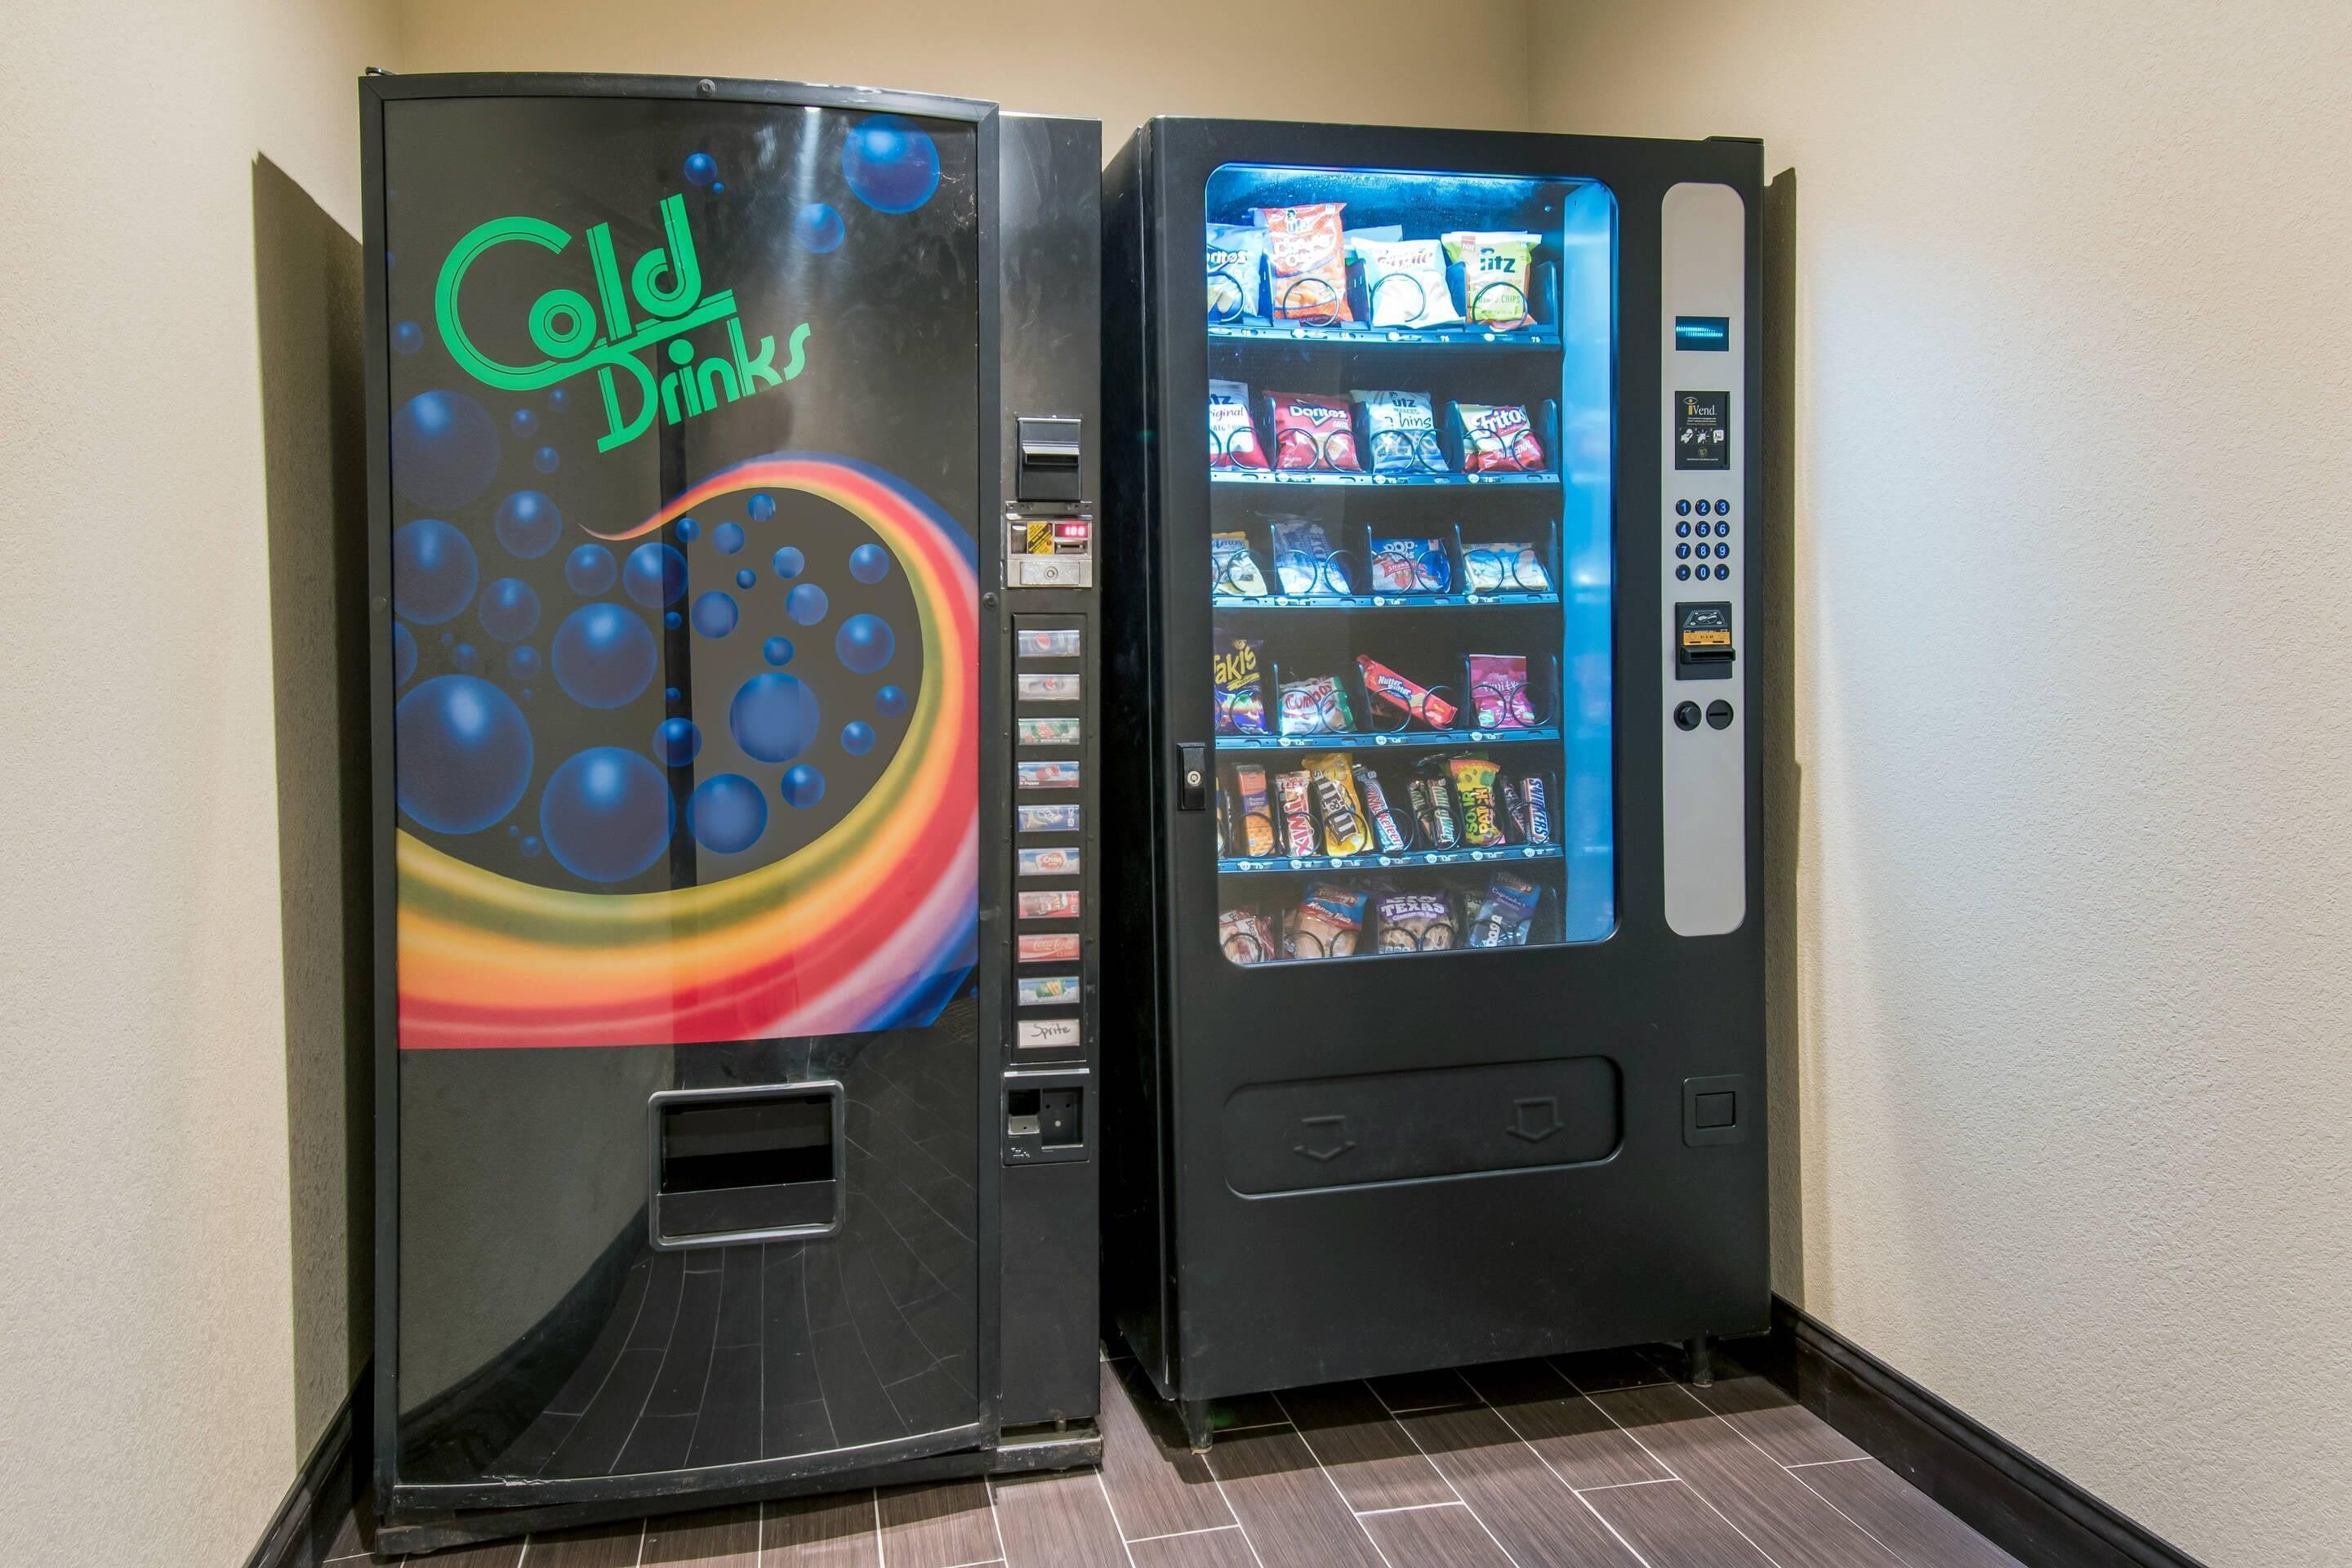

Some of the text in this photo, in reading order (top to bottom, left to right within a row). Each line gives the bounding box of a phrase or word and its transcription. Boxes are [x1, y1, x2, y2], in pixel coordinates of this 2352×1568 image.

[434, 193, 737, 392] Cold
[596, 317, 811, 453] Drinks
[1210, 407, 1244, 421] iginal
[1290, 405, 1348, 419] Doritos
[1471, 408, 1526, 437] Fritos
[1682, 502, 1726, 513] 1 2 3
[1681, 523, 1726, 534] 4 5 6
[1681, 546, 1726, 556] 7 8 9
[1700, 568, 1706, 577] 0
[1378, 675, 1403, 687] Nutter
[1431, 786, 1450, 817] Mily
[1307, 901, 1334, 917] Honey
[1334, 911, 1352, 924] Bun
[1380, 902, 1445, 917] TEXAS
[1031, 1023, 1071, 1040] Sprite
